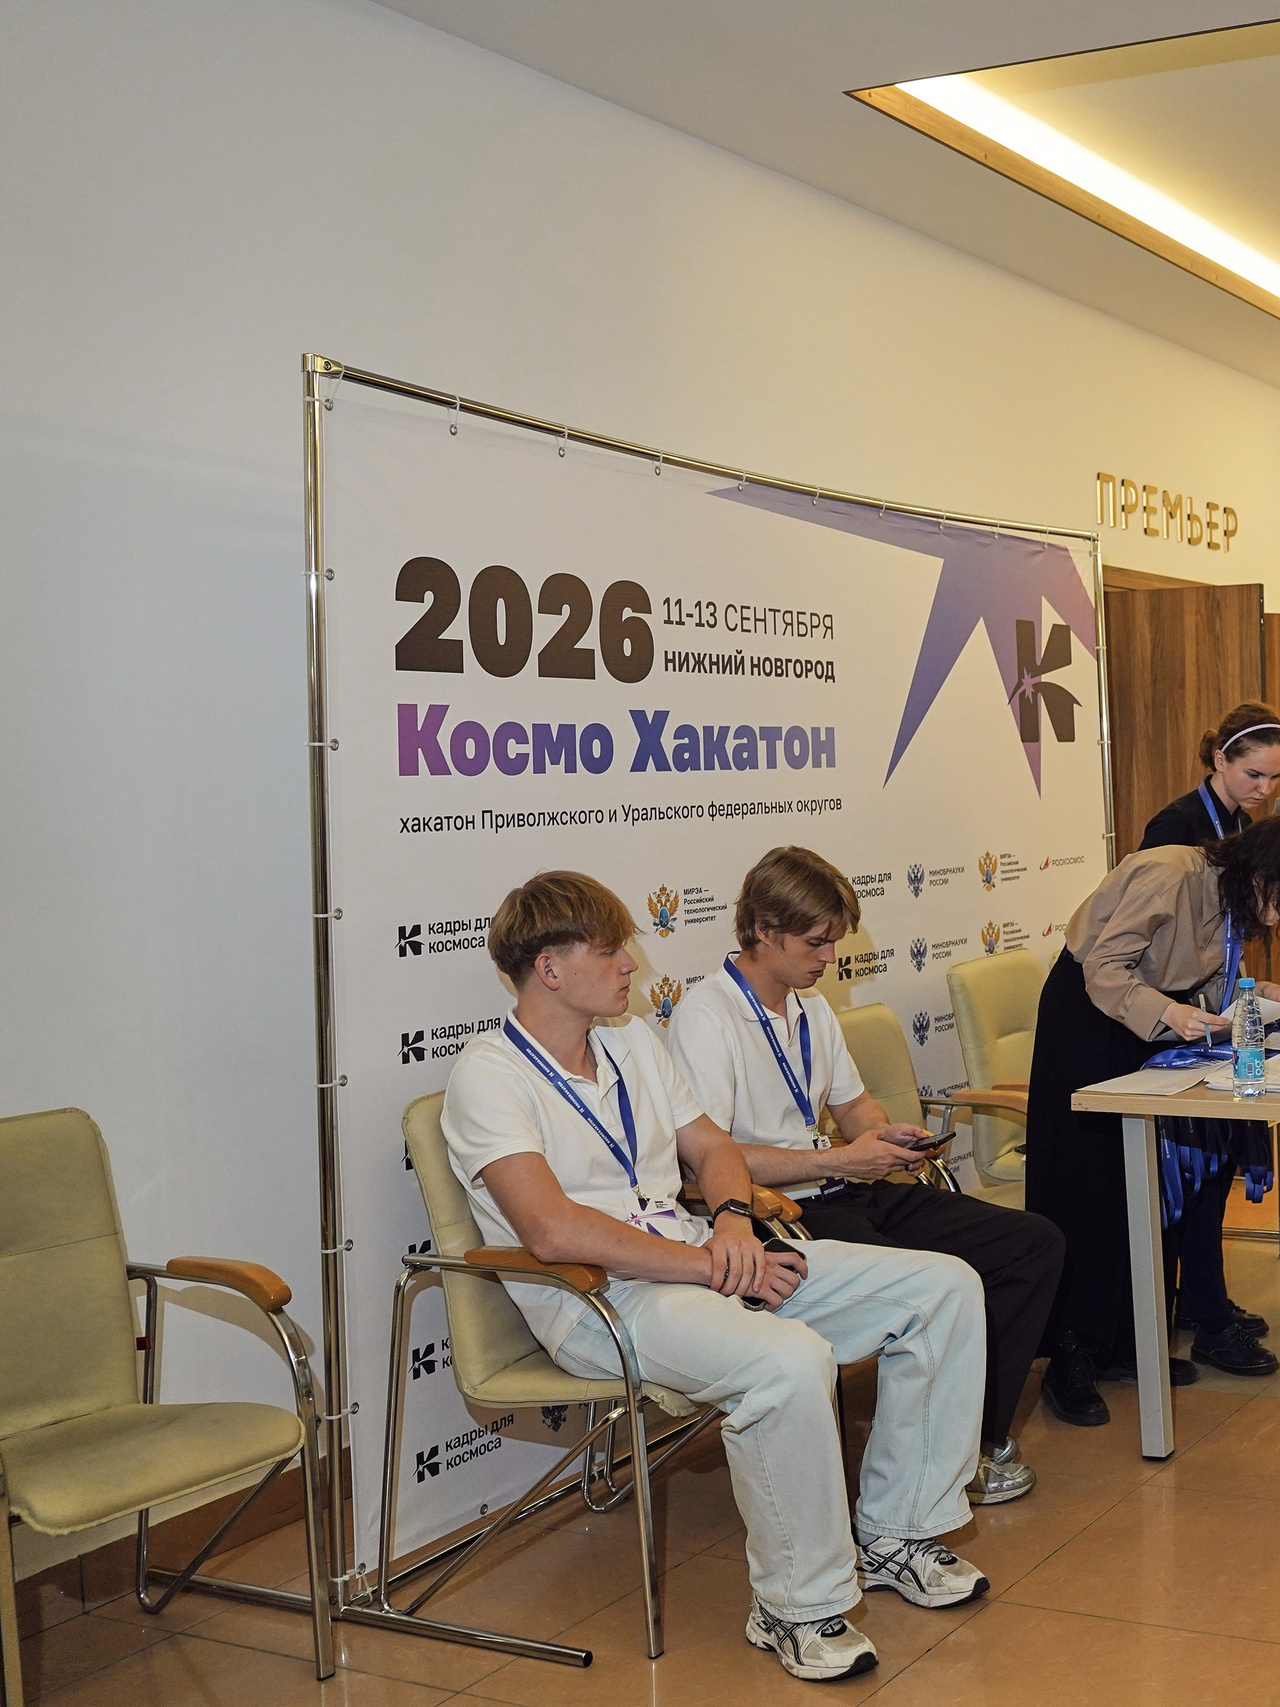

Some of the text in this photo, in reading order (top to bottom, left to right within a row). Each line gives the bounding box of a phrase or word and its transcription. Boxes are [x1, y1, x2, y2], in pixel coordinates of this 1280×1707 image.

[1096, 470, 1239, 555] ПРЕМЬЕР
[395, 557, 654, 683] 2026
[663, 597, 833, 639] 11-13 СЕНТЯБРЯ
[664, 649, 835, 683] НИЖНИЙ НОВГОРОД
[398, 704, 835, 776] Космо Хакатон
[400, 799, 842, 834] хакатон Приволжского и Уральского федеральных округов
[1052, 856, 1085, 867] РОСКОСМОС
[852, 872, 892, 886] кадры для
[929, 866, 965, 877] МИНОБРНАУКИ
[929, 878, 949, 886] РОССИИ
[683, 887, 702, 895] МИРЭА
[683, 896, 714, 905] Российский
[684, 904, 727, 915] технологический
[428, 917, 492, 936] кадры дл
[684, 915, 716, 926] университет
[428, 936, 486, 953] космоса
[931, 938, 968, 950] МИНОБРНАУКИ
[854, 948, 894, 964] кадры для
[932, 950, 951, 960] РОССИИ
[855, 963, 888, 978] космоса
[934, 1012, 955, 1023] МИНОБР
[431, 1017, 501, 1040] кадры для
[934, 1022, 954, 1033] РОССИИ
[431, 1041, 469, 1059] косм
[445, 1413, 514, 1452] кадры для
[446, 1436, 502, 1471] космоса
